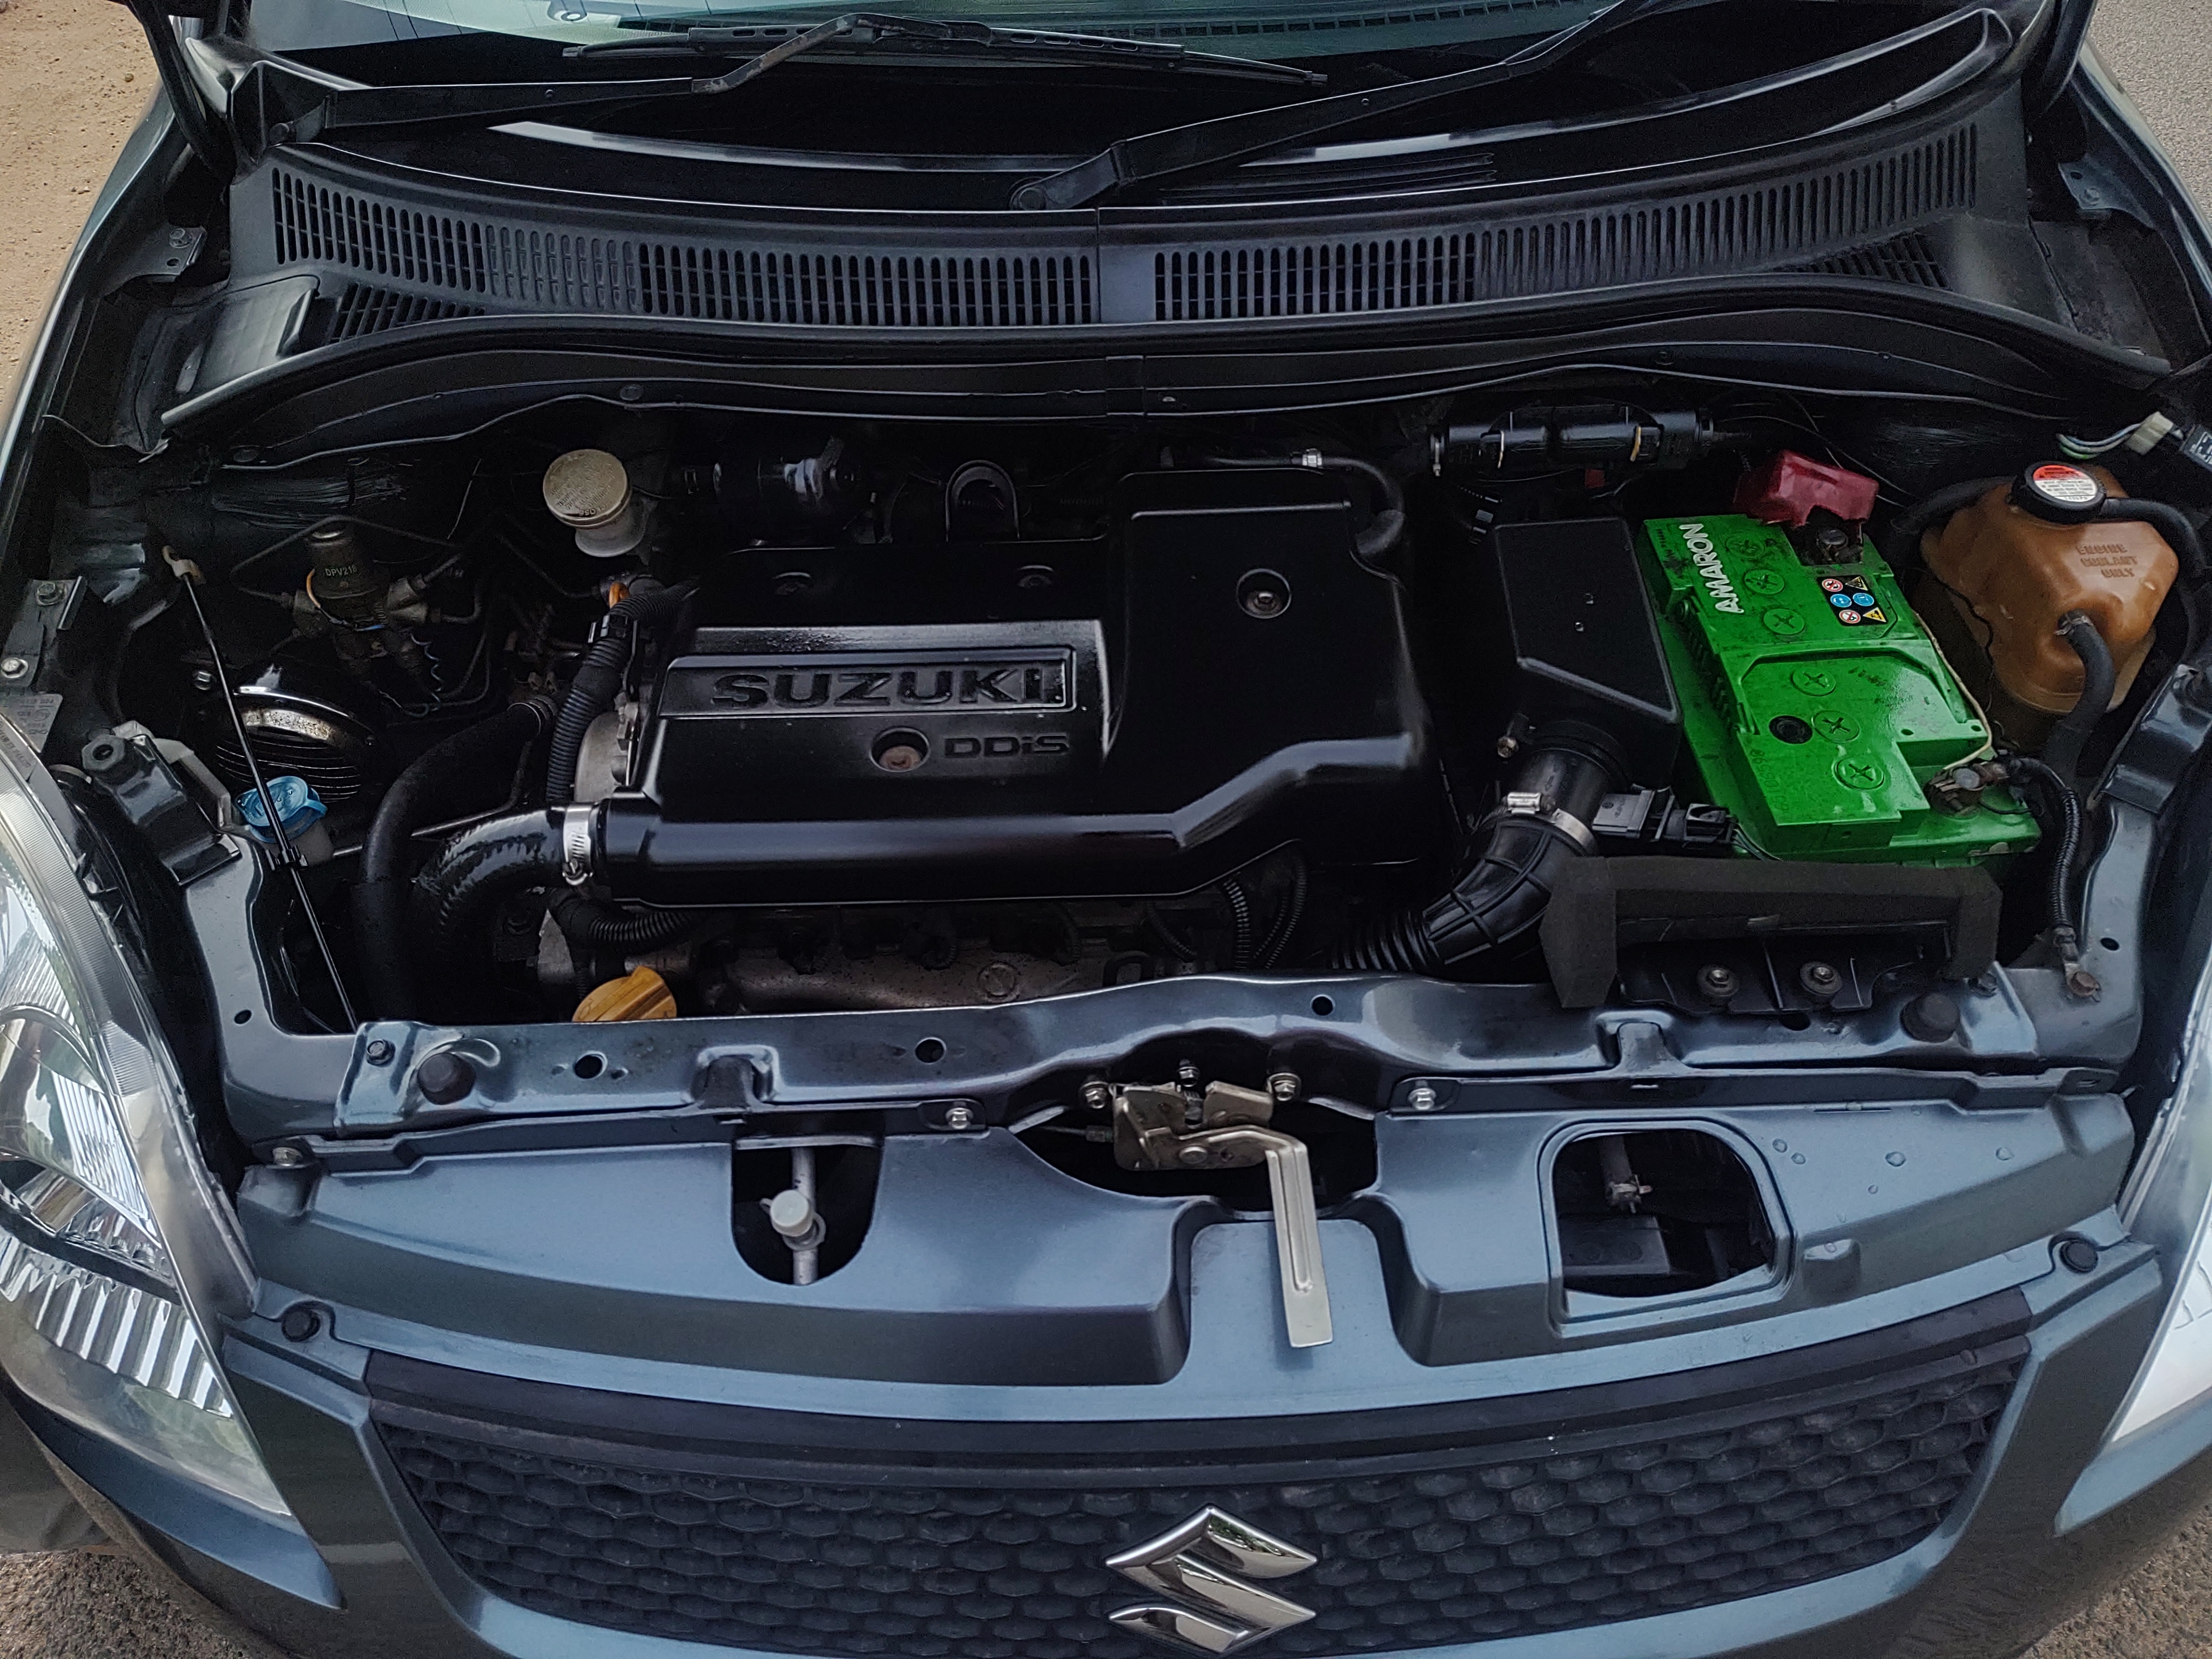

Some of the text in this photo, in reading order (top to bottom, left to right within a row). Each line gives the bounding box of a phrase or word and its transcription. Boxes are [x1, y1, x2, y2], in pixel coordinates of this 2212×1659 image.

[325, 564, 357, 576] DPV218
[1678, 523, 1744, 613] AMARON
[712, 670, 1042, 708] SUZUKI
[944, 734, 1069, 756] DDiS
